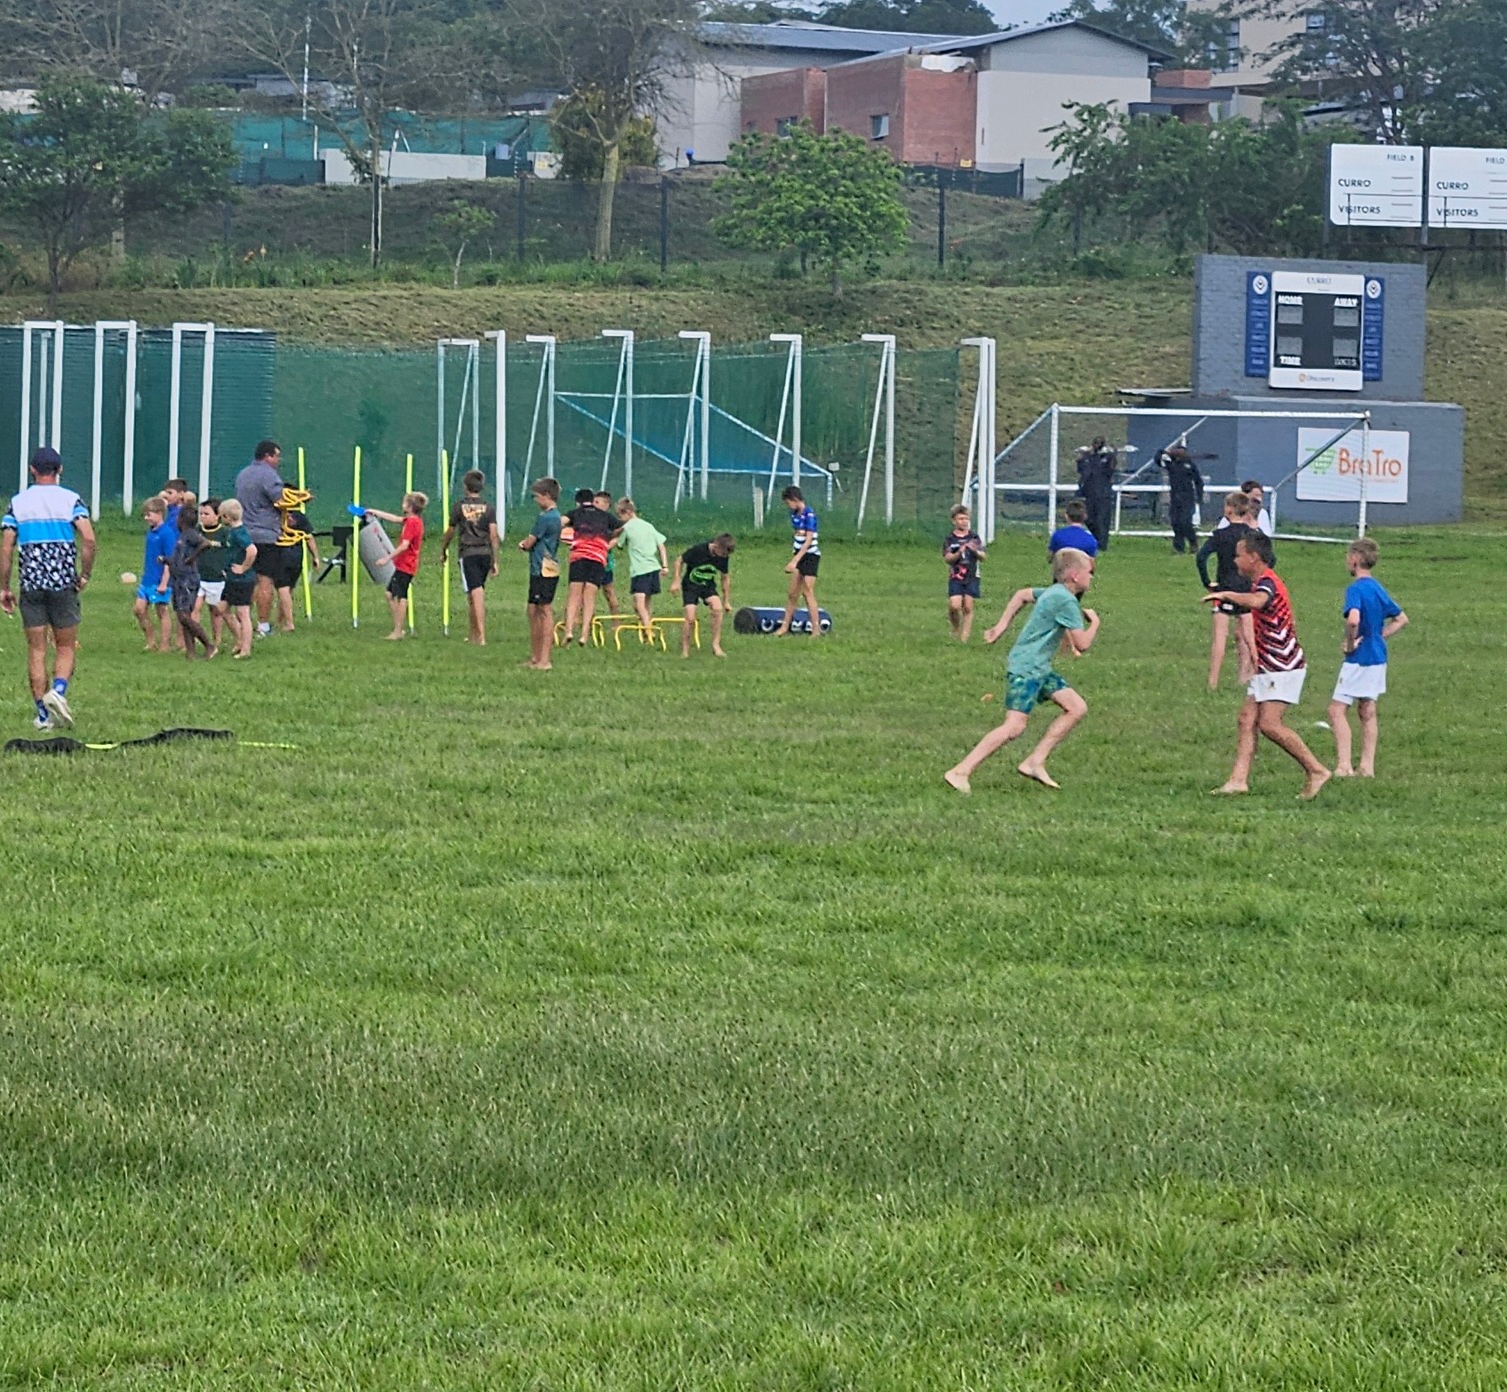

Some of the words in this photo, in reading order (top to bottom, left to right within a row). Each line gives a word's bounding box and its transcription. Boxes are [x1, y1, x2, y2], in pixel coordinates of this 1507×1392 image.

[1338, 178, 1371, 187] CURRO
[1436, 181, 1469, 190] CURRO
[1338, 205, 1380, 214] VISITORS
[1436, 208, 1478, 217] VSITORS
[1339, 447, 1402, 476] BraTro
